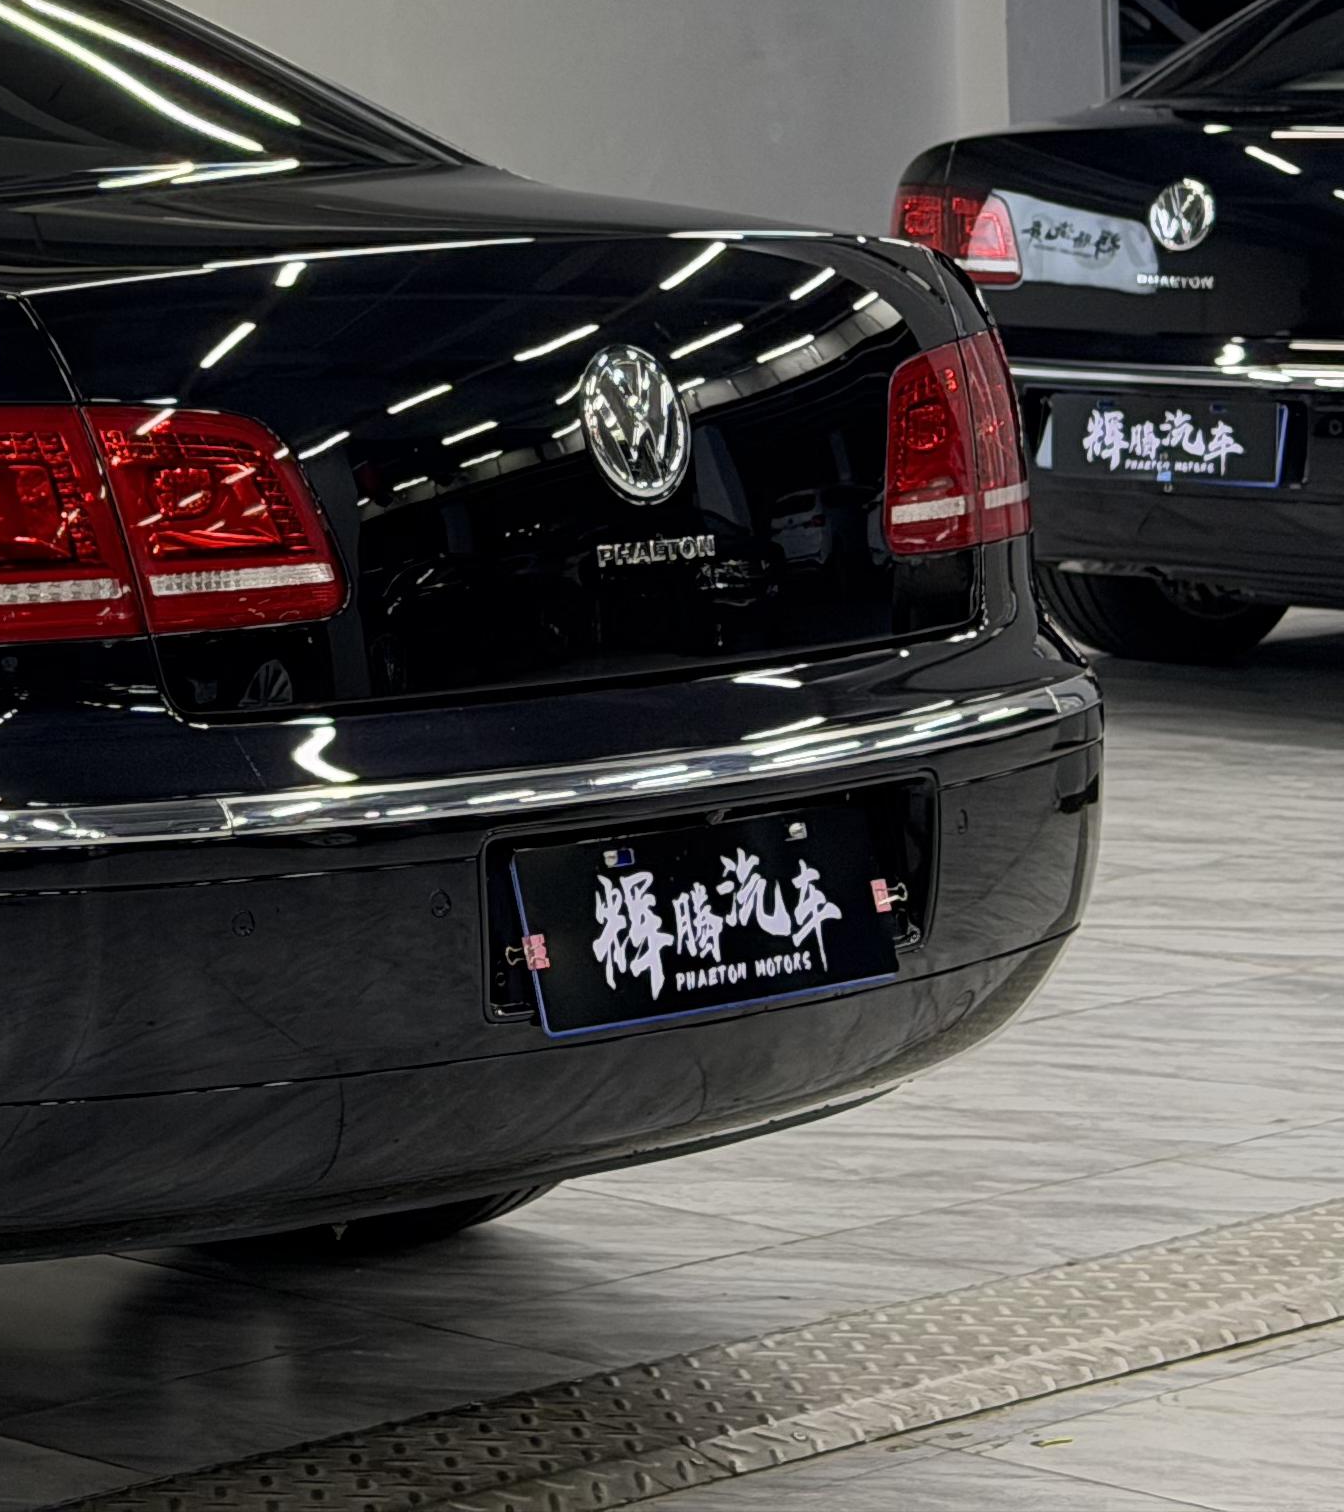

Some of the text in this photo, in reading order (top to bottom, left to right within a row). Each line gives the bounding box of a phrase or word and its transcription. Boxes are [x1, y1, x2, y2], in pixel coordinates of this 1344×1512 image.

[597, 534, 716, 569] PHAETON
[676, 950, 812, 992] PHAETON MOTORS
